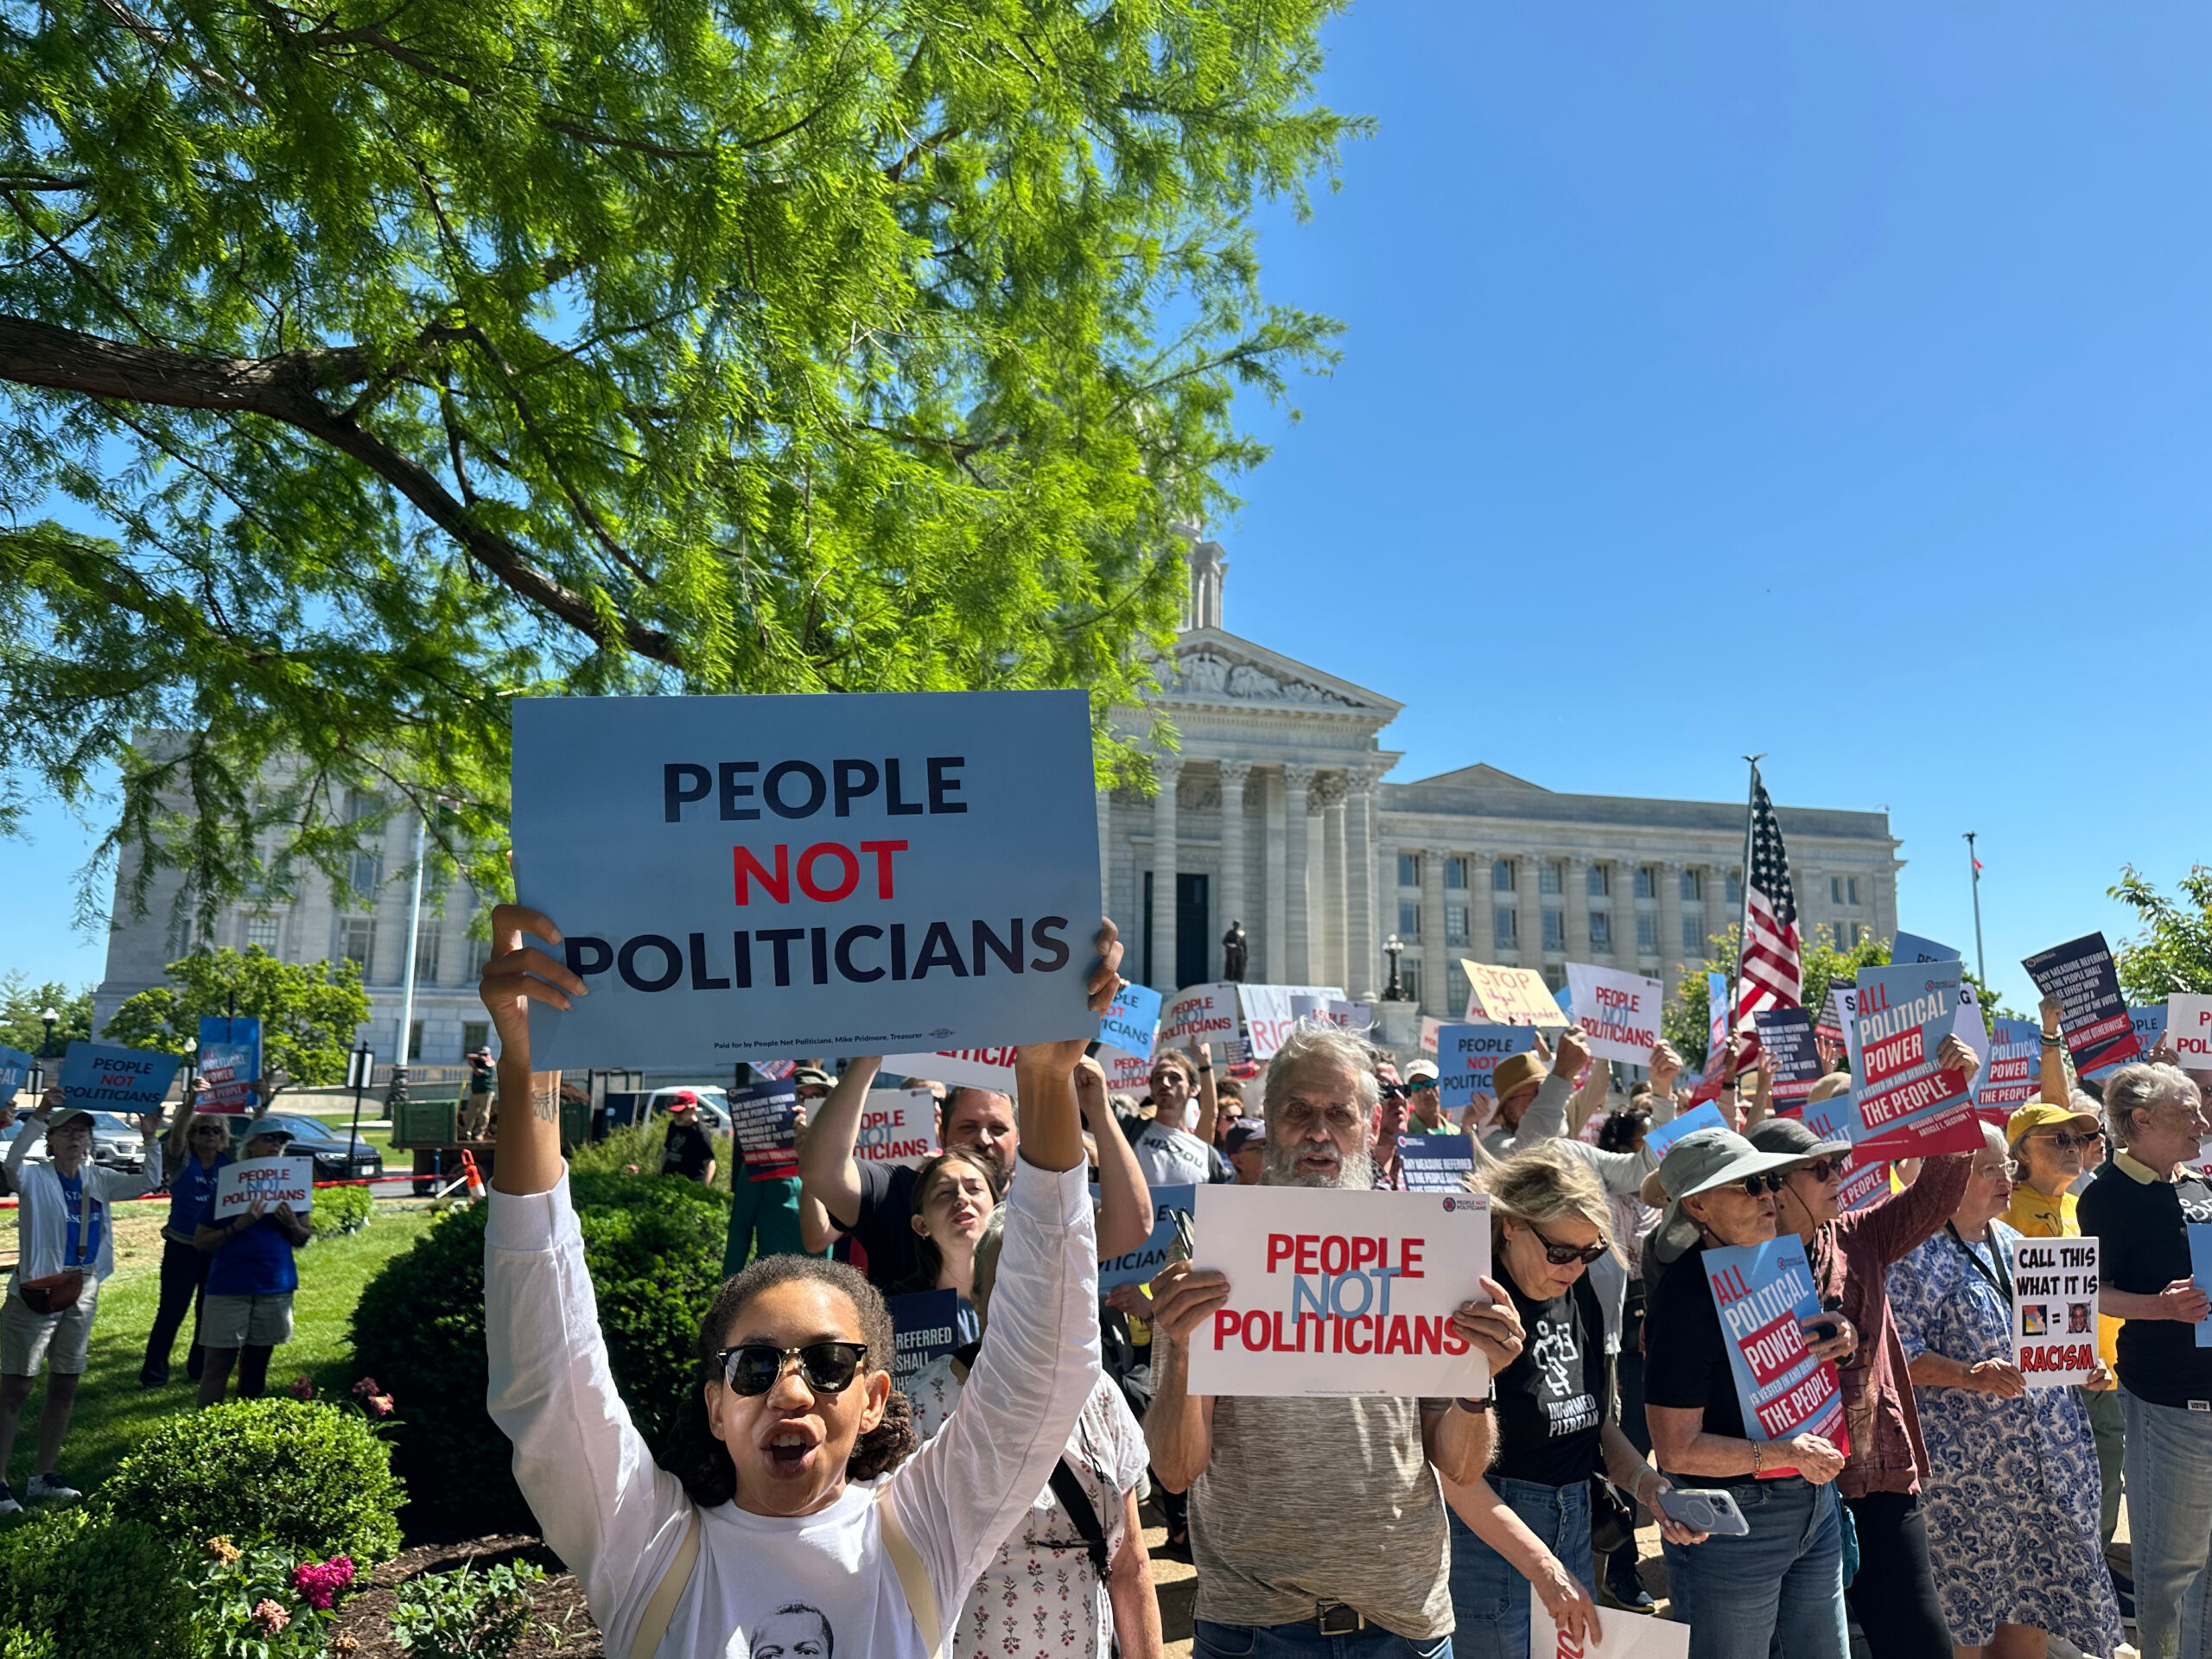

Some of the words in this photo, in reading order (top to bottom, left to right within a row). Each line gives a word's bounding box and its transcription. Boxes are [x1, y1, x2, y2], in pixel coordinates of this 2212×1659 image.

[664, 757, 968, 823] PEOPLE
[733, 840, 908, 906] NOT
[563, 916, 1070, 991] POLITICIANS
[1477, 967, 1529, 990] STOP
[1112, 993, 1140, 1008] PLE
[1172, 996, 1214, 1016] PEOPLE
[1596, 986, 1640, 1013] PEOPLE
[1859, 982, 1891, 1018] ALL
[1105, 1007, 1126, 1019] OT
[1176, 1007, 1207, 1025] NOT
[1601, 1005, 1631, 1027] NOT
[1859, 991, 1948, 1046] POLITICAL
[1160, 1017, 1232, 1044] POLITICIANS
[1581, 1016, 1655, 1048] POLITICIANS
[1993, 1027, 2011, 1045] ALL
[2130, 1018, 2158, 1032] OPLE
[753, 1040, 779, 1049] People
[795, 1037, 834, 1046] Politicians,
[854, 1034, 889, 1043] Pridmore,
[1459, 1039, 1514, 1052] PEOPLE
[1992, 1039, 2039, 1061] POLITICAL
[2138, 1033, 2151, 1046] OT
[92, 1057, 154, 1074] PEOPLE
[1466, 1057, 1500, 1070] NOT
[1865, 1033, 1923, 1077] POWER
[100, 1074, 137, 1087] NOT
[1906, 1064, 1934, 1082] DERIVED
[1990, 1061, 2028, 1079] POWER
[1444, 1074, 1493, 1090] POLITIC
[64, 1085, 162, 1103] POLITICIANS
[1862, 1097, 1892, 1126] THE
[1890, 1074, 1952, 1115] PEOPLE
[1980, 1090, 1997, 1103] THE
[1999, 1086, 2033, 1103] PEOPLE
[860, 1109, 905, 1130] OPLE
[238, 1168, 290, 1183] PEOPLE
[247, 1177, 283, 1192] NOT
[1847, 1168, 1883, 1203] PEOPLE
[222, 1189, 306, 1207] POLITICIANS
[1266, 1233, 1426, 1279] PEOPLE
[2018, 1248, 2056, 1269] CALL
[2060, 1247, 2096, 1268] THIS
[1291, 1266, 1402, 1324] NOT
[1711, 1264, 1753, 1307] ALL
[2016, 1275, 2061, 1297] WHAT
[2064, 1275, 2079, 1295] IT
[2083, 1274, 2098, 1295] IS
[1724, 1268, 1810, 1341] POLITICAL
[895, 1326, 953, 1350] REFERRED
[1213, 1310, 1471, 1356] POLITICIANS
[1744, 1319, 1803, 1376] POWER
[2020, 1344, 2094, 1373] RACISM
[1749, 1392, 1760, 1406] IS
[1758, 1381, 1783, 1401] VESTED
[1780, 1376, 1791, 1388] IN
[1789, 1366, 1802, 1383] AND
[1760, 1398, 1797, 1434] THE
[1790, 1367, 1834, 1417] PEOPLE
[1548, 1410, 1599, 1438] PLEBEIAN
